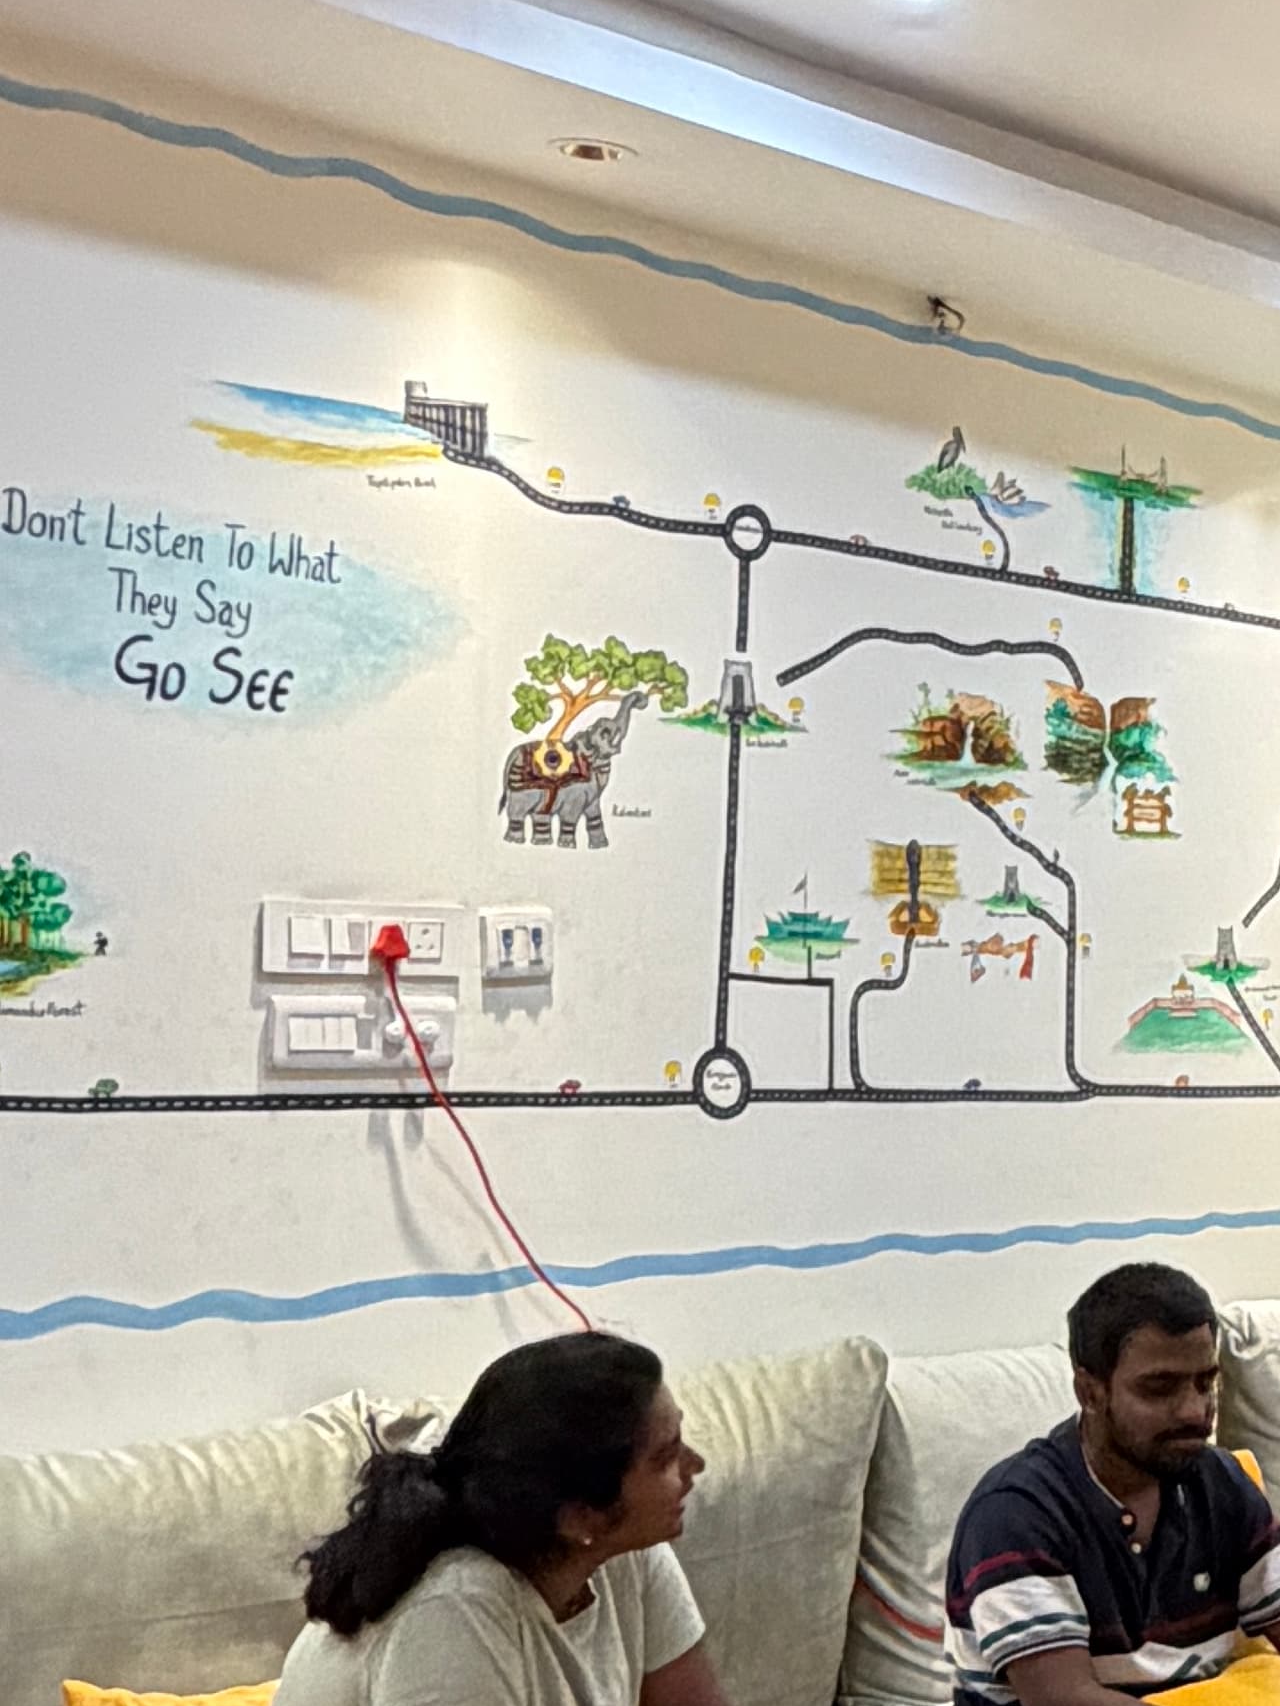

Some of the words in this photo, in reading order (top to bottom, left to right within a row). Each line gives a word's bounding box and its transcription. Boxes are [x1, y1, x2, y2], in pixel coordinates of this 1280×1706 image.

[2, 486, 87, 547] Don't
[105, 501, 204, 564] Listen
[225, 522, 255, 572] To
[269, 530, 343, 585] What
[107, 566, 177, 630] They
[195, 579, 253, 639] Say
